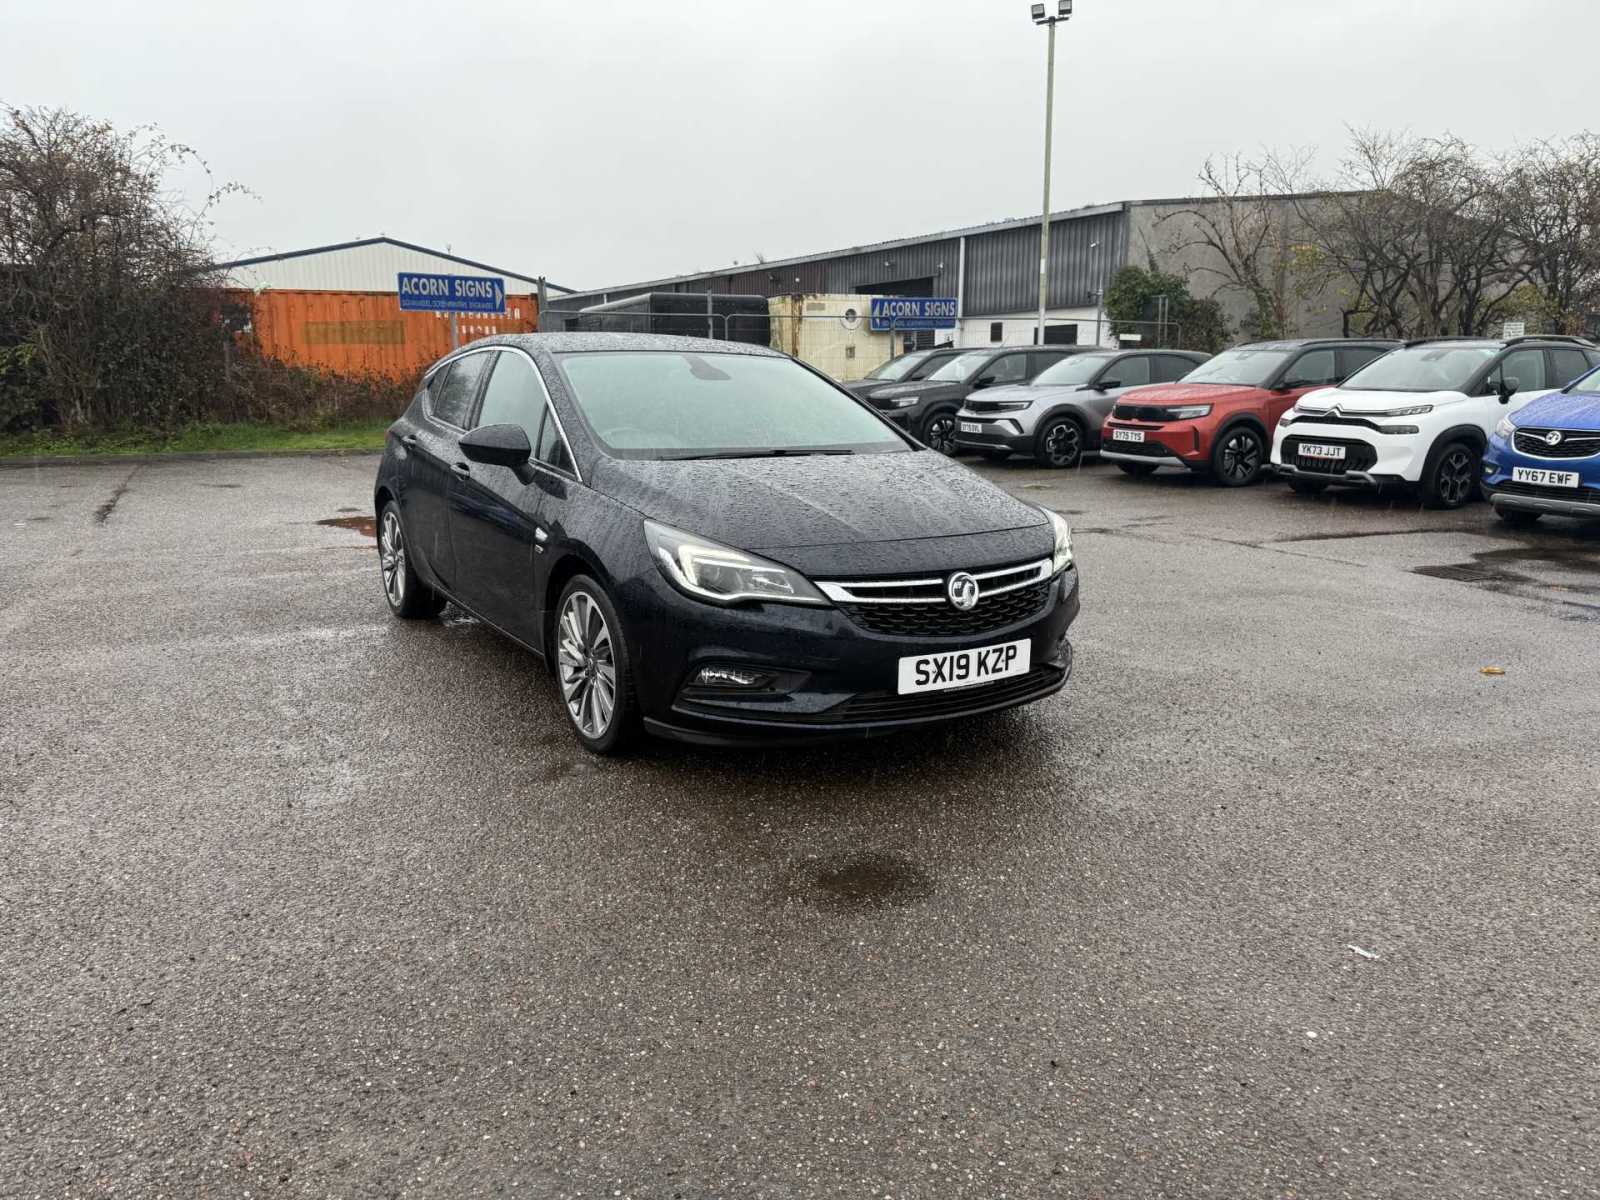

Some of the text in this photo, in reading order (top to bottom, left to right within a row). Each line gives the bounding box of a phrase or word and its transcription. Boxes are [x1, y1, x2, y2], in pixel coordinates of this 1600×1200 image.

[402, 277, 493, 298] ACORN SIGNS
[882, 301, 955, 317] ACORN SIGNS
[1301, 444, 1342, 457] YK73 JJT
[1517, 469, 1573, 485] YY67 EWF
[915, 645, 1017, 686] SX19 KZP
